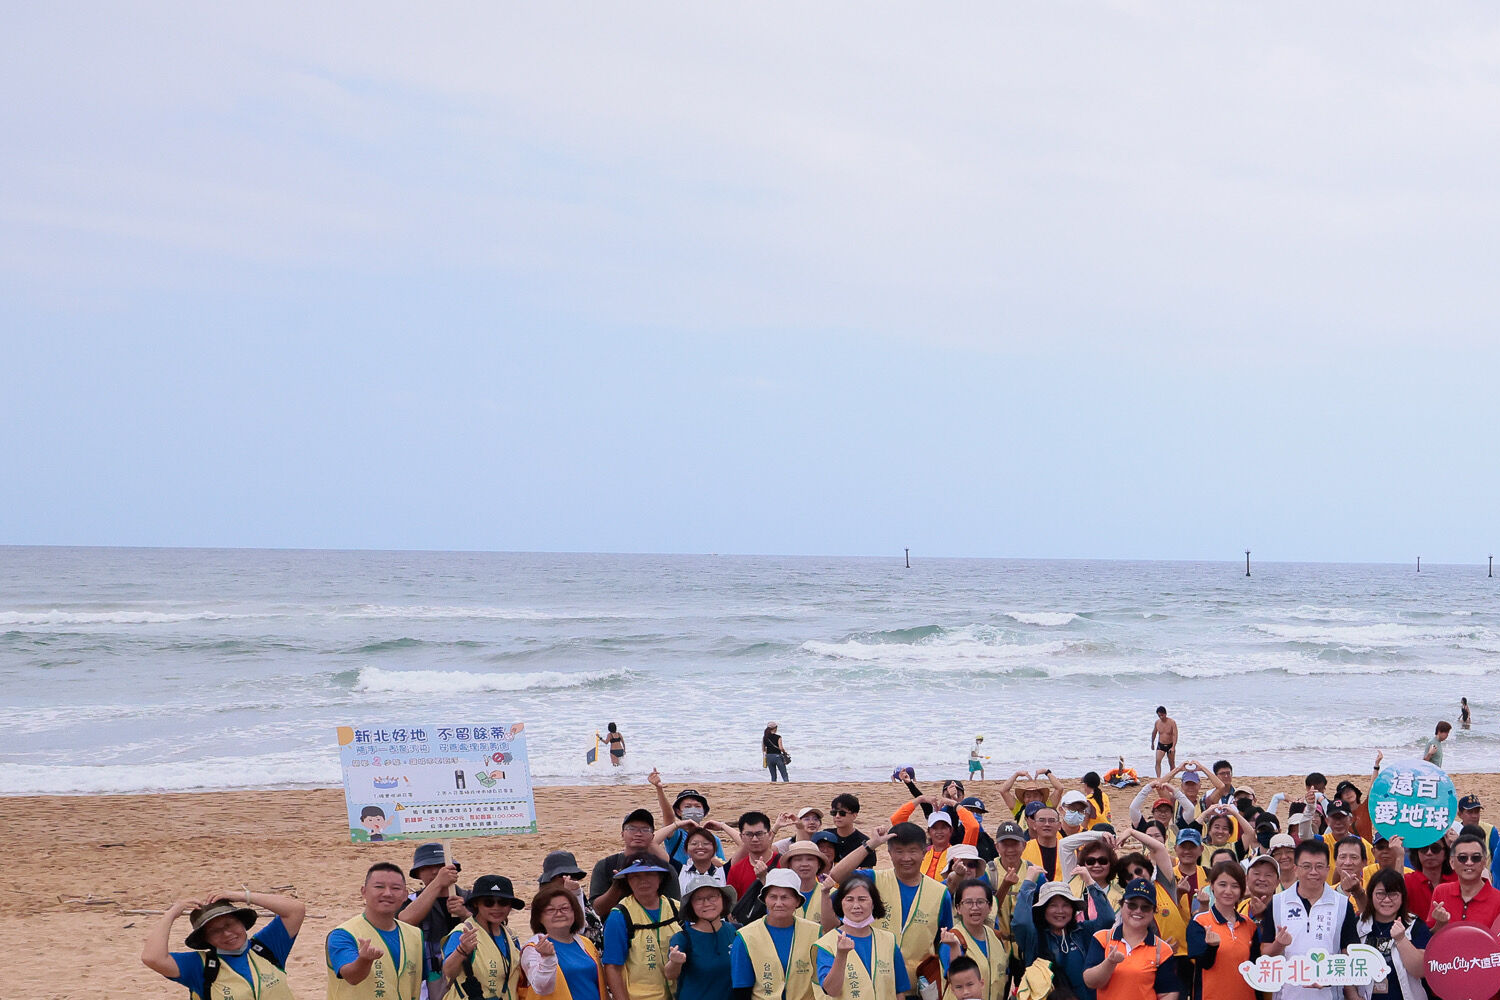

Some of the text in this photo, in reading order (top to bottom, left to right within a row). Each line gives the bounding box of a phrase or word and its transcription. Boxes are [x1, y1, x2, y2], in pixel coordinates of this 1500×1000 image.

[354, 729, 428, 743] 新北好地
[1389, 770, 1440, 798] 遠百
[1375, 801, 1449, 831] 愛地球
[847, 962, 861, 998] 台塑企業
